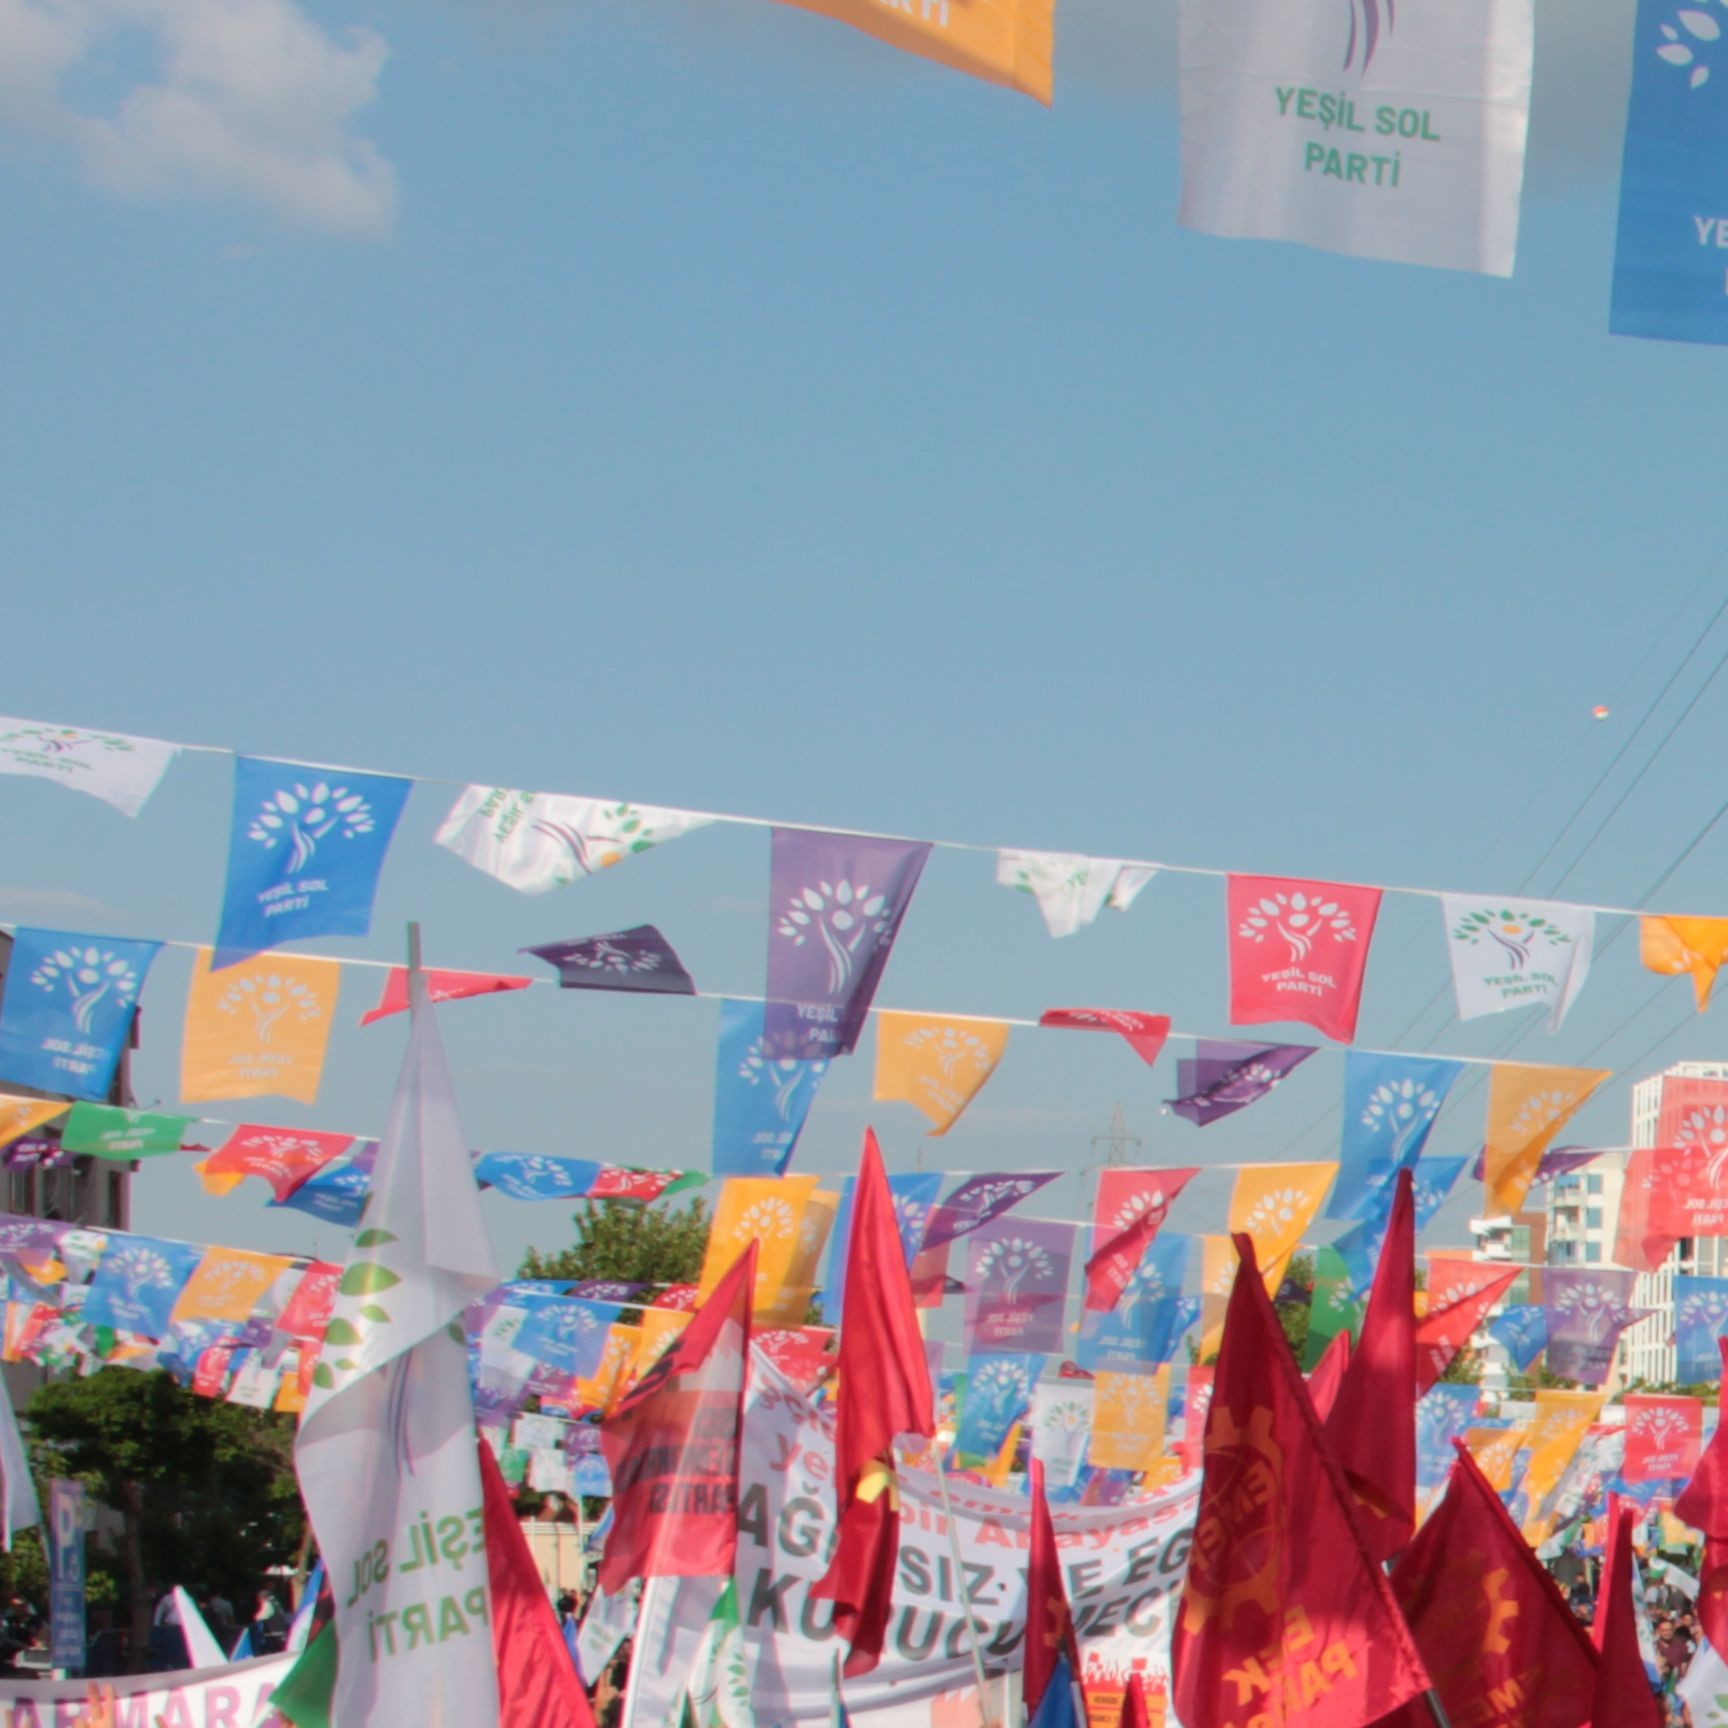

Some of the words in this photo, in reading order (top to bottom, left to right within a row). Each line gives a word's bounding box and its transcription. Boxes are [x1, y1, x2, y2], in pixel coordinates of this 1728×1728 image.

[1274, 86, 1365, 134] YEŞİL
[1374, 106, 1441, 142] SOL
[1304, 141, 1401, 188] PARTİ
